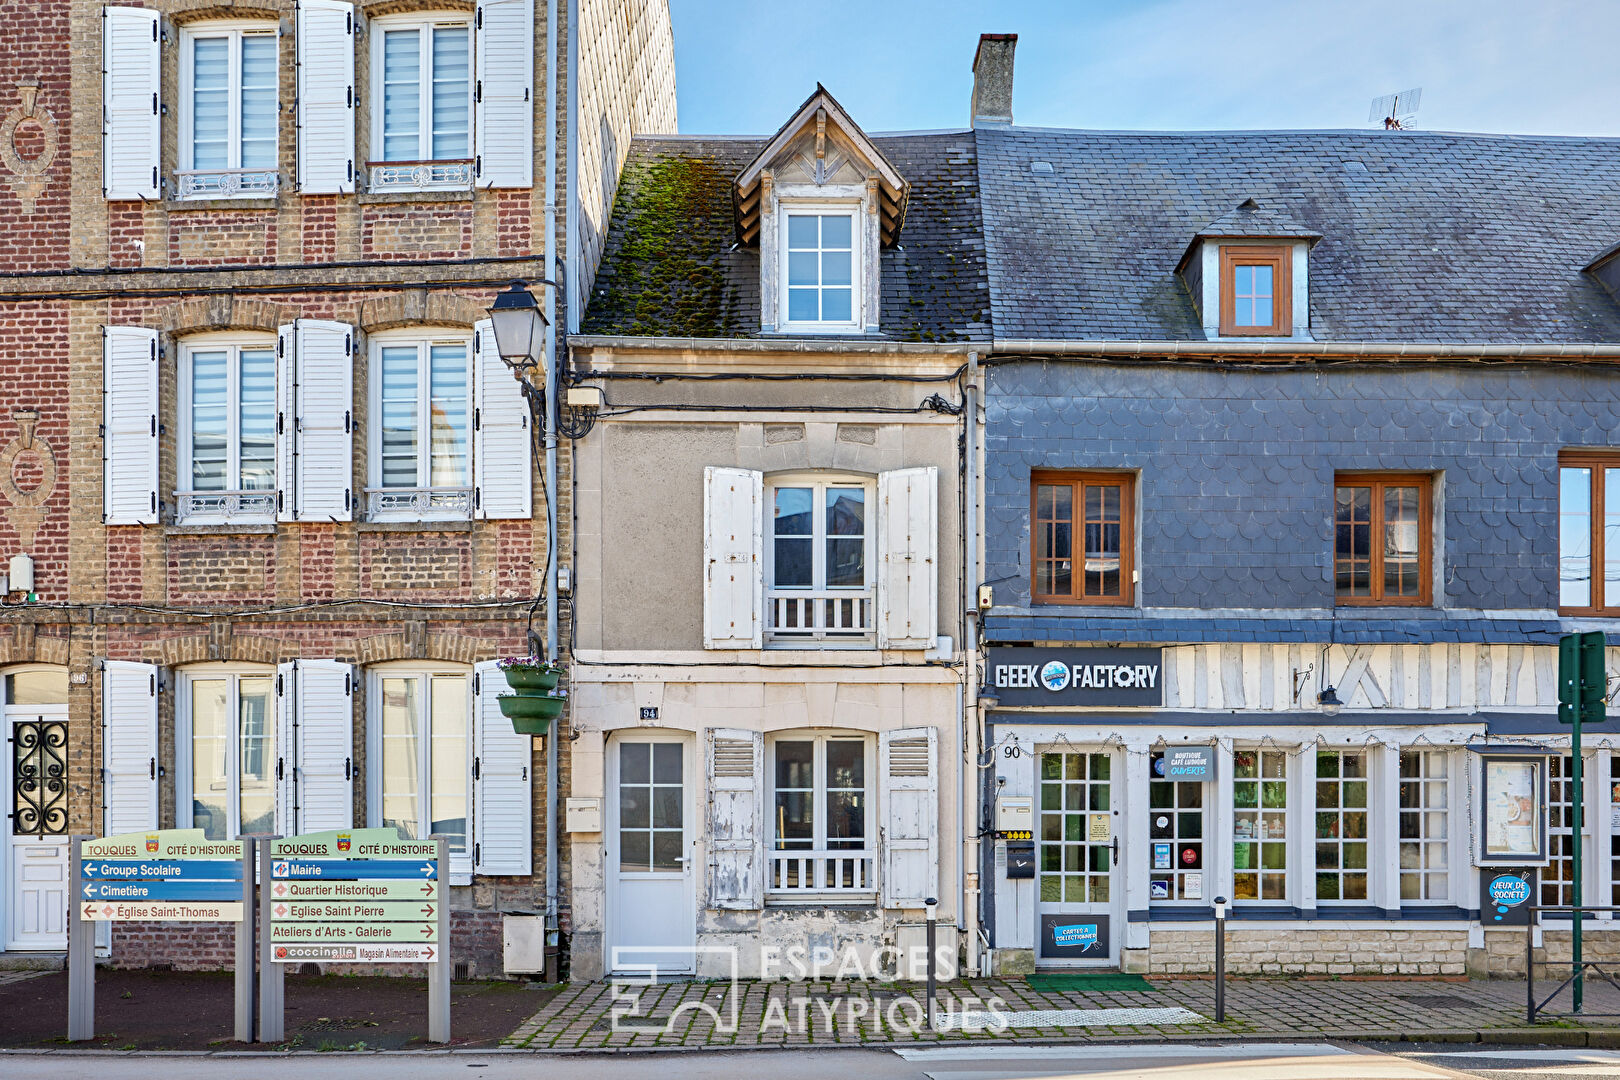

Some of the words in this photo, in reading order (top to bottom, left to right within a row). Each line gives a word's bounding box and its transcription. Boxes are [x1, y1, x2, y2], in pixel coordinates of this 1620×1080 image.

[995, 665, 1039, 688] GEEK
[1072, 665, 1158, 688] FACTORY
[644, 709, 655, 718] 94
[1004, 747, 1020, 758] 90
[1171, 767, 1206, 775] OUVERTS
[88, 845, 137, 856] TOUQUES
[167, 844, 188, 855] CITÉ
[190, 844, 241, 855] D'HISTOIRE
[278, 844, 328, 854] TOUQUES
[359, 843, 380, 855] CITÉ
[382, 844, 435, 855] D'HISTOIRE
[101, 865, 138, 877] Groupe
[140, 865, 181, 876] Scolaire
[291, 865, 321, 876] Mairie
[101, 885, 148, 896] Cimetière
[1493, 881, 1513, 889] JEUX
[290, 885, 332, 896] Quartier
[335, 885, 388, 897] Historique
[118, 905, 148, 919] Église
[151, 907, 219, 918] Saint-Thomas
[291, 906, 322, 918] Eglise
[324, 906, 351, 916] Saint
[354, 906, 384, 916] Pierre
[273, 927, 312, 937] Ateliers
[315, 927, 346, 937] d'Arts
[356, 927, 391, 937] Galerie
[290, 947, 353, 956] coccinelle
[360, 949, 384, 960] Magasin
[385, 948, 419, 958] Alimentaire
